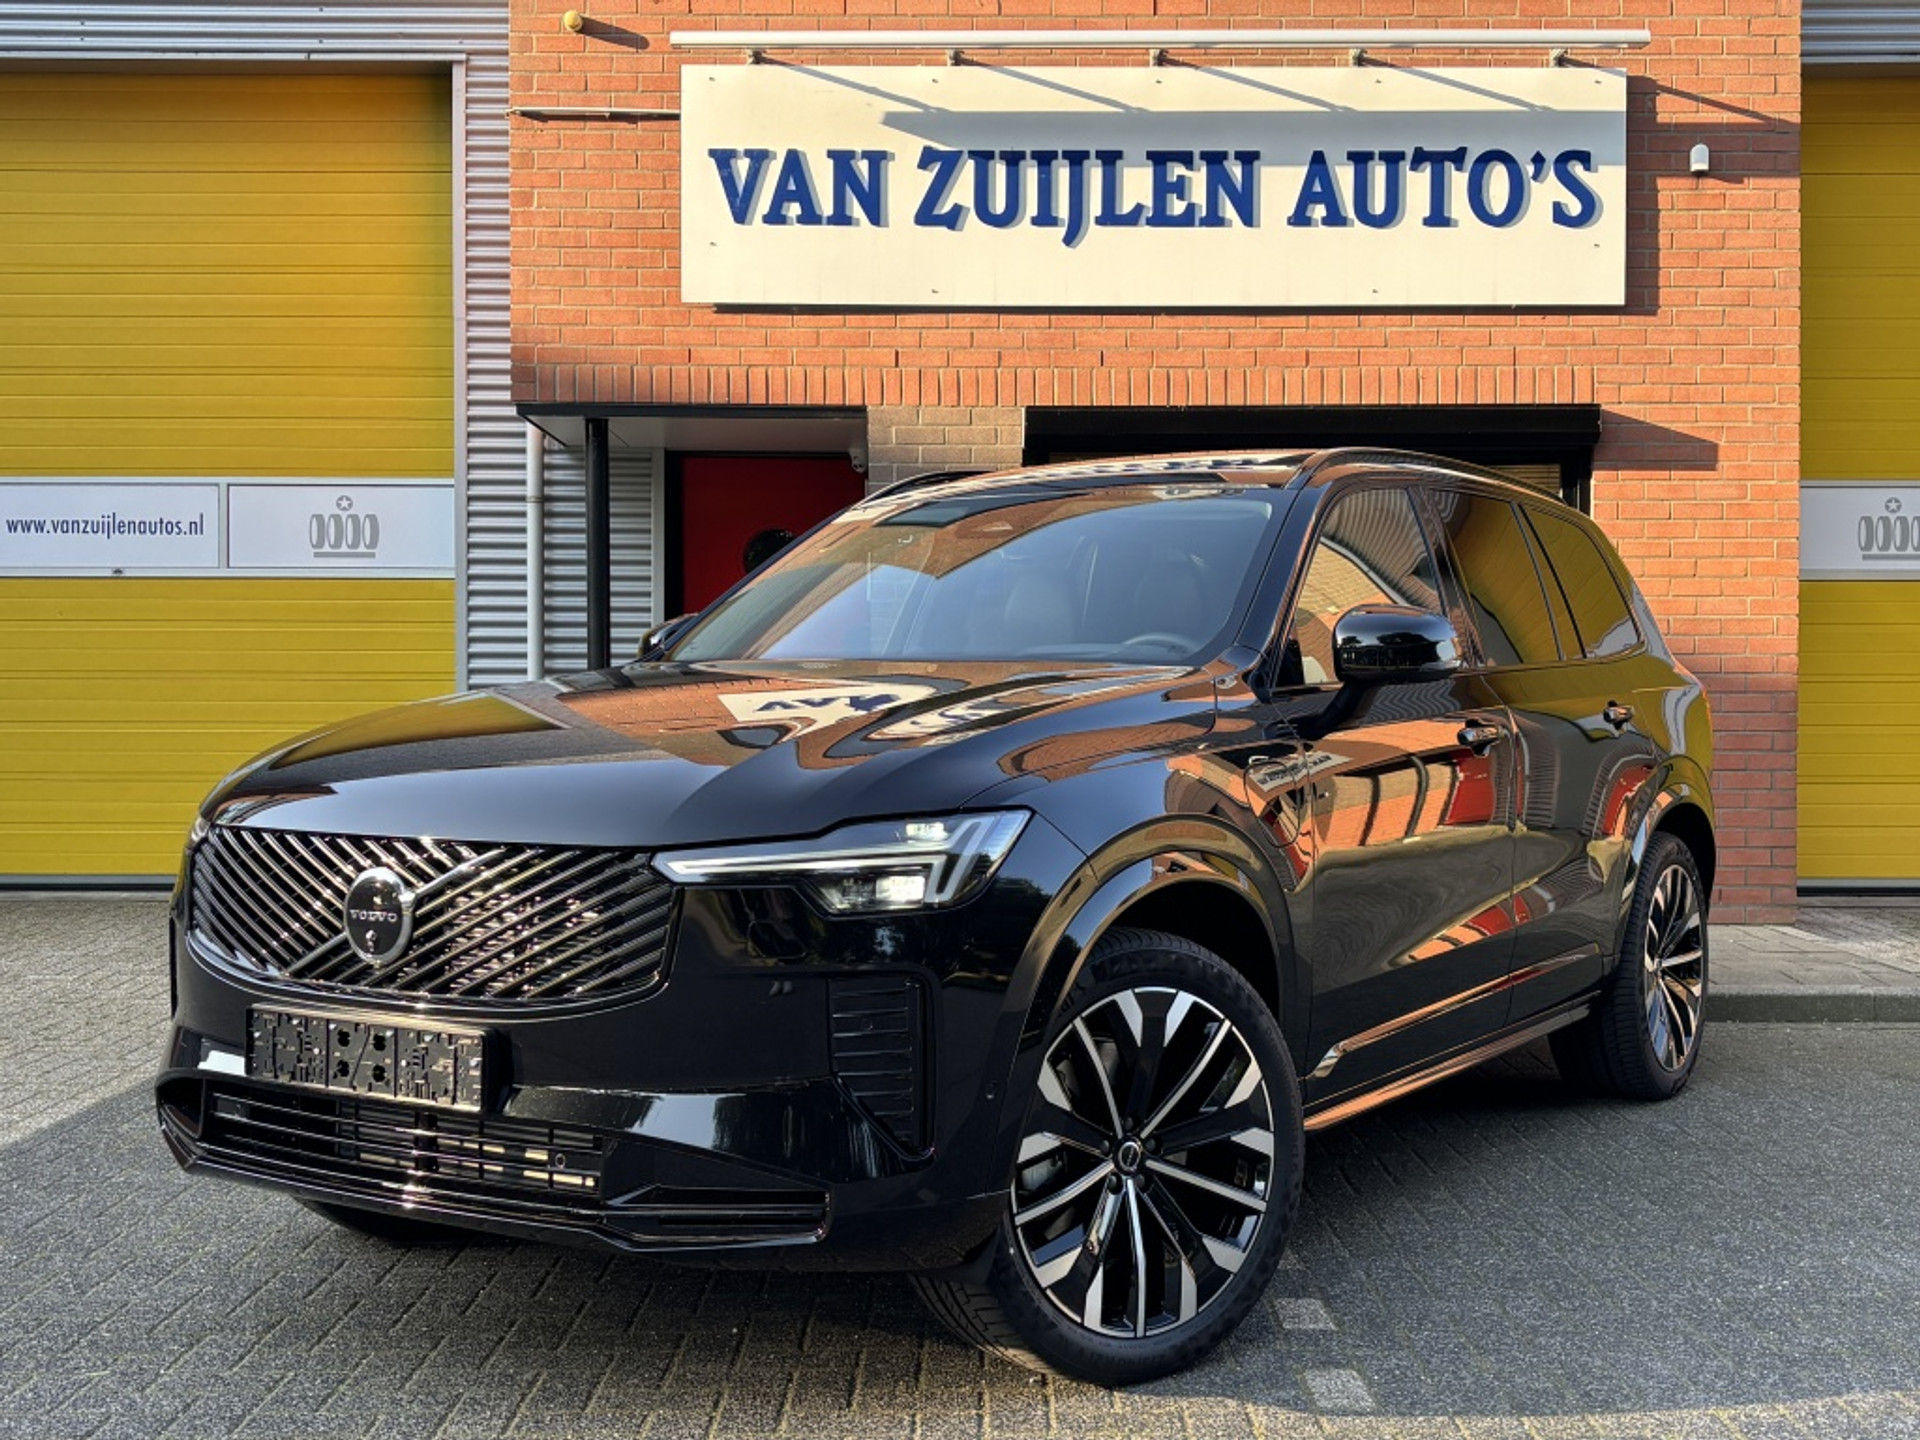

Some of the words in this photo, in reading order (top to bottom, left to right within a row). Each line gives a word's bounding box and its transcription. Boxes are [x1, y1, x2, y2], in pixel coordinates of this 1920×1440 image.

[708, 148, 889, 227] VAN
[915, 146, 1257, 248] ZUIJLEN
[1286, 146, 1599, 228] AUTO'S
[6, 512, 204, 540] www.vanzuijlenautos.nl
[349, 908, 398, 922] VOLVO
